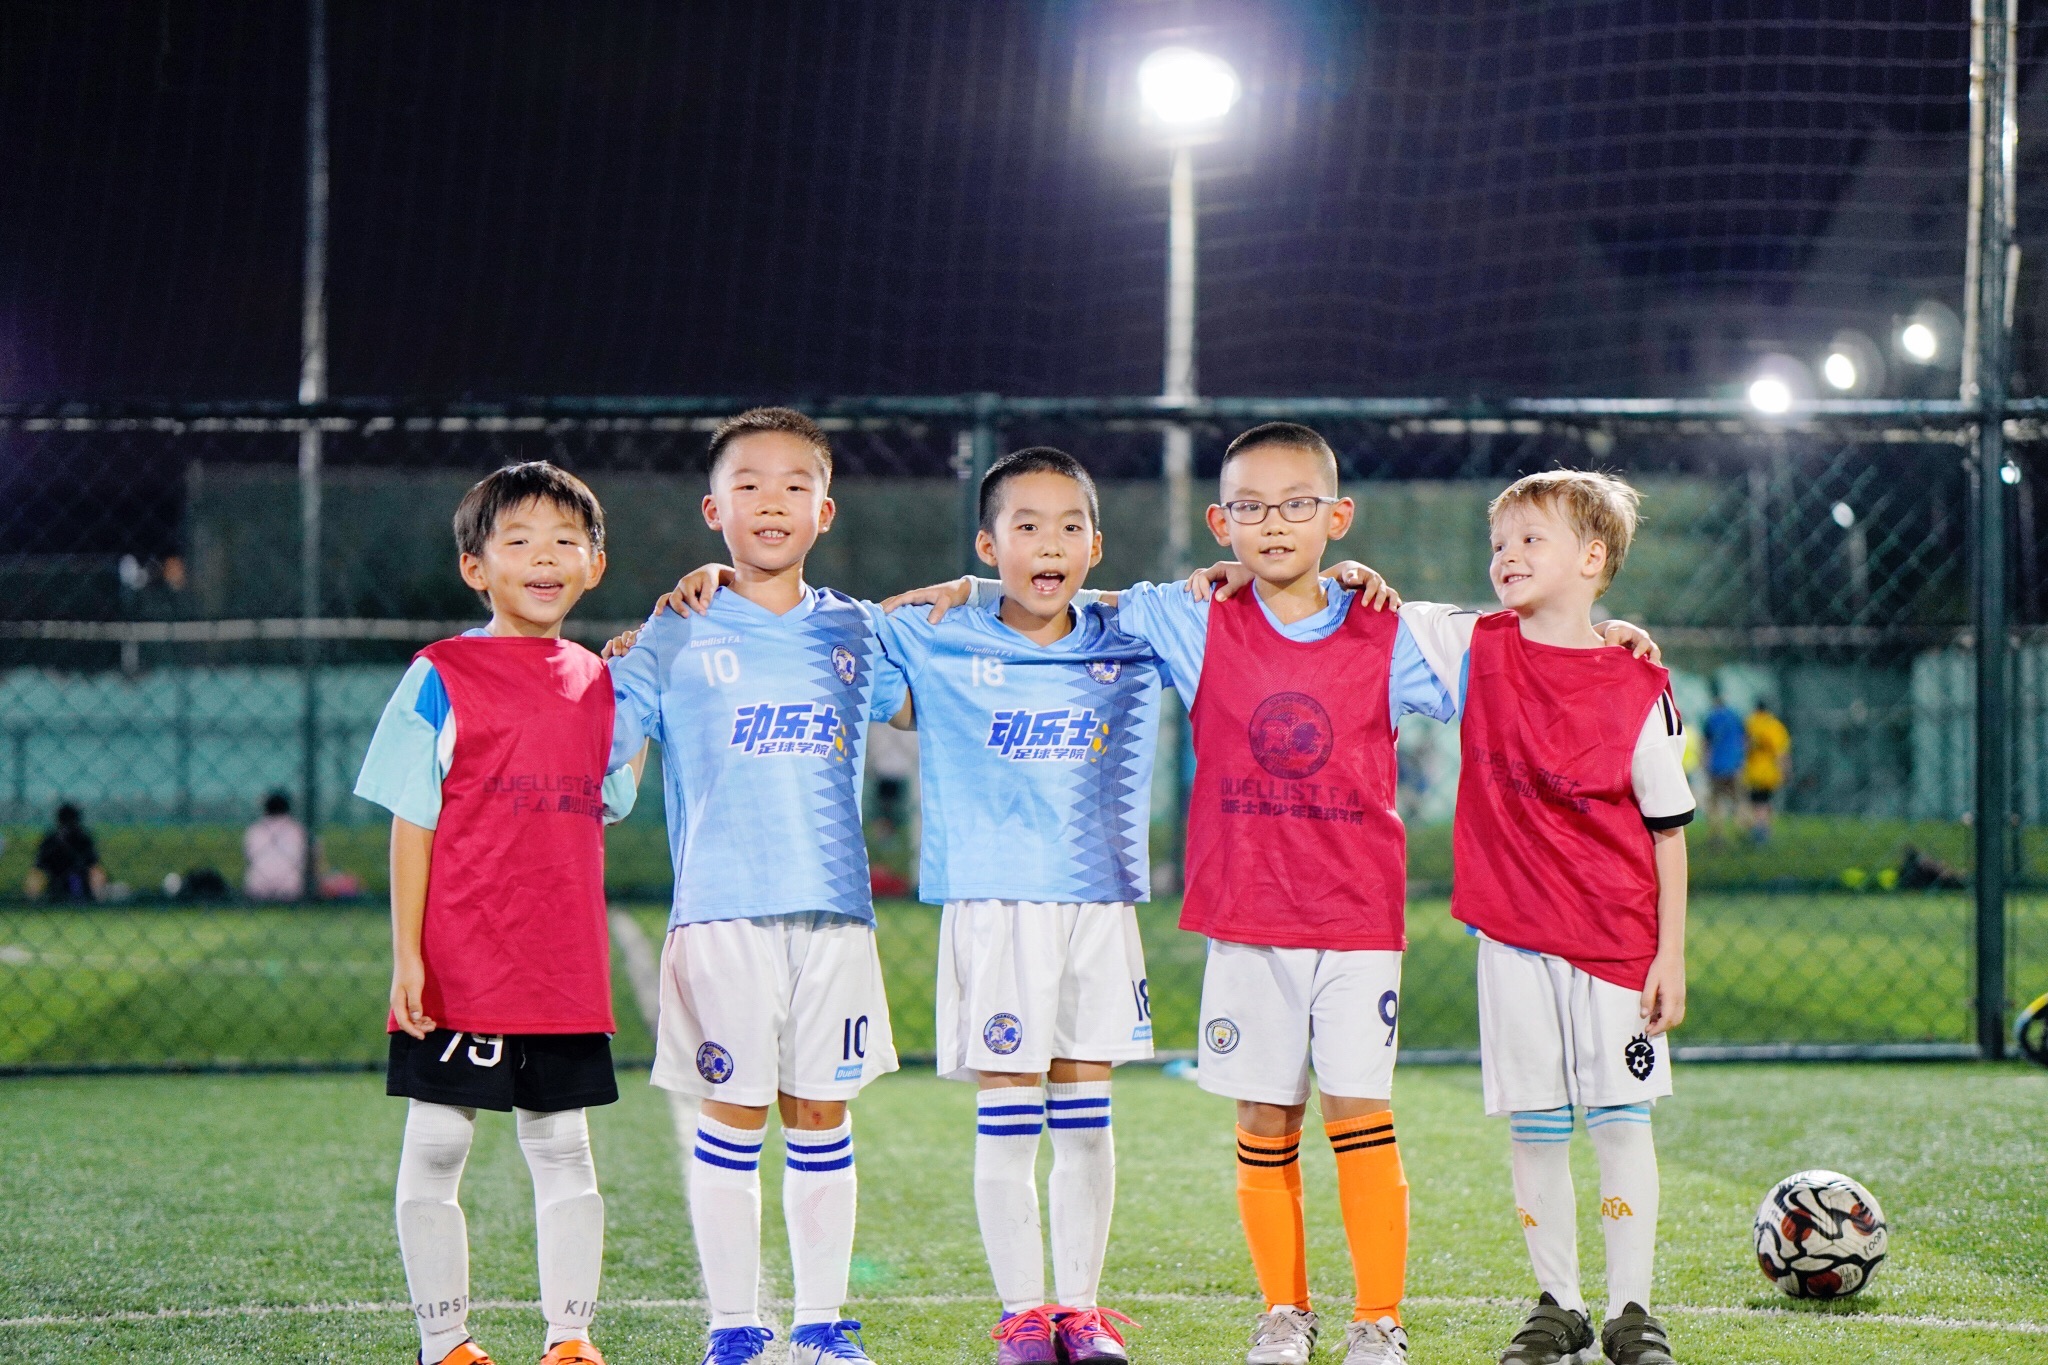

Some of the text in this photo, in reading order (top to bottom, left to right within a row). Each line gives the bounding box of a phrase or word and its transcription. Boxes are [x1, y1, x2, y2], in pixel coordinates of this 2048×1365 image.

[701, 648, 740, 688] 10
[972, 655, 1005, 688] 18
[731, 703, 839, 752] 动乐士
[987, 709, 1097, 756] 动乐士
[757, 741, 830, 756] 足球学院
[1013, 748, 1084, 760] 足球学院
[843, 1015, 869, 1060] 10
[1378, 990, 1398, 1047] 9
[1601, 1196, 1633, 1220] AFA
